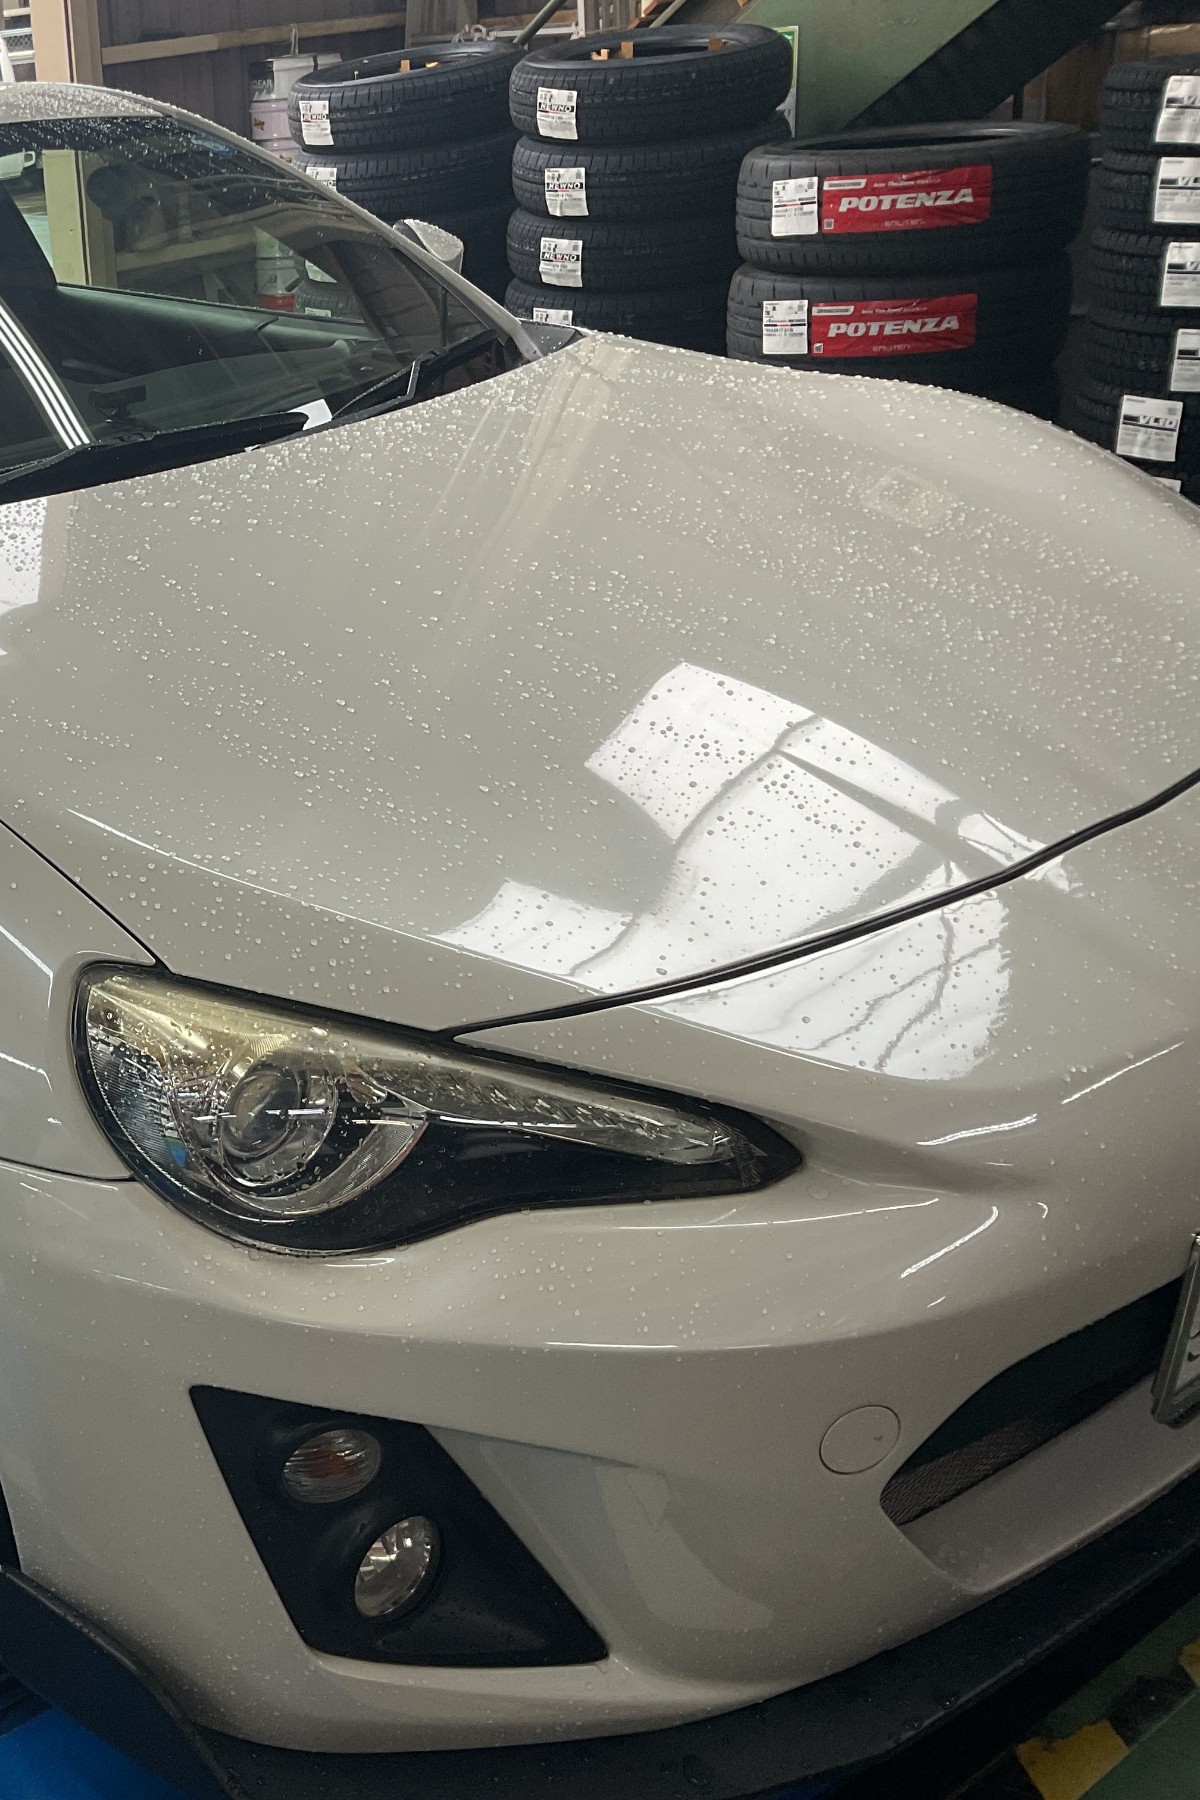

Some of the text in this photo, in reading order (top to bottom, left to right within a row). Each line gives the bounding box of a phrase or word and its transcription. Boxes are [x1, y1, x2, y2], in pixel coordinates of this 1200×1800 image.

[549, 182, 580, 190] NEWNO
[838, 188, 974, 212] POTENZA
[544, 252, 577, 260] NEWNO
[827, 315, 960, 337] POTENZA
[1140, 415, 1178, 428] VL10
